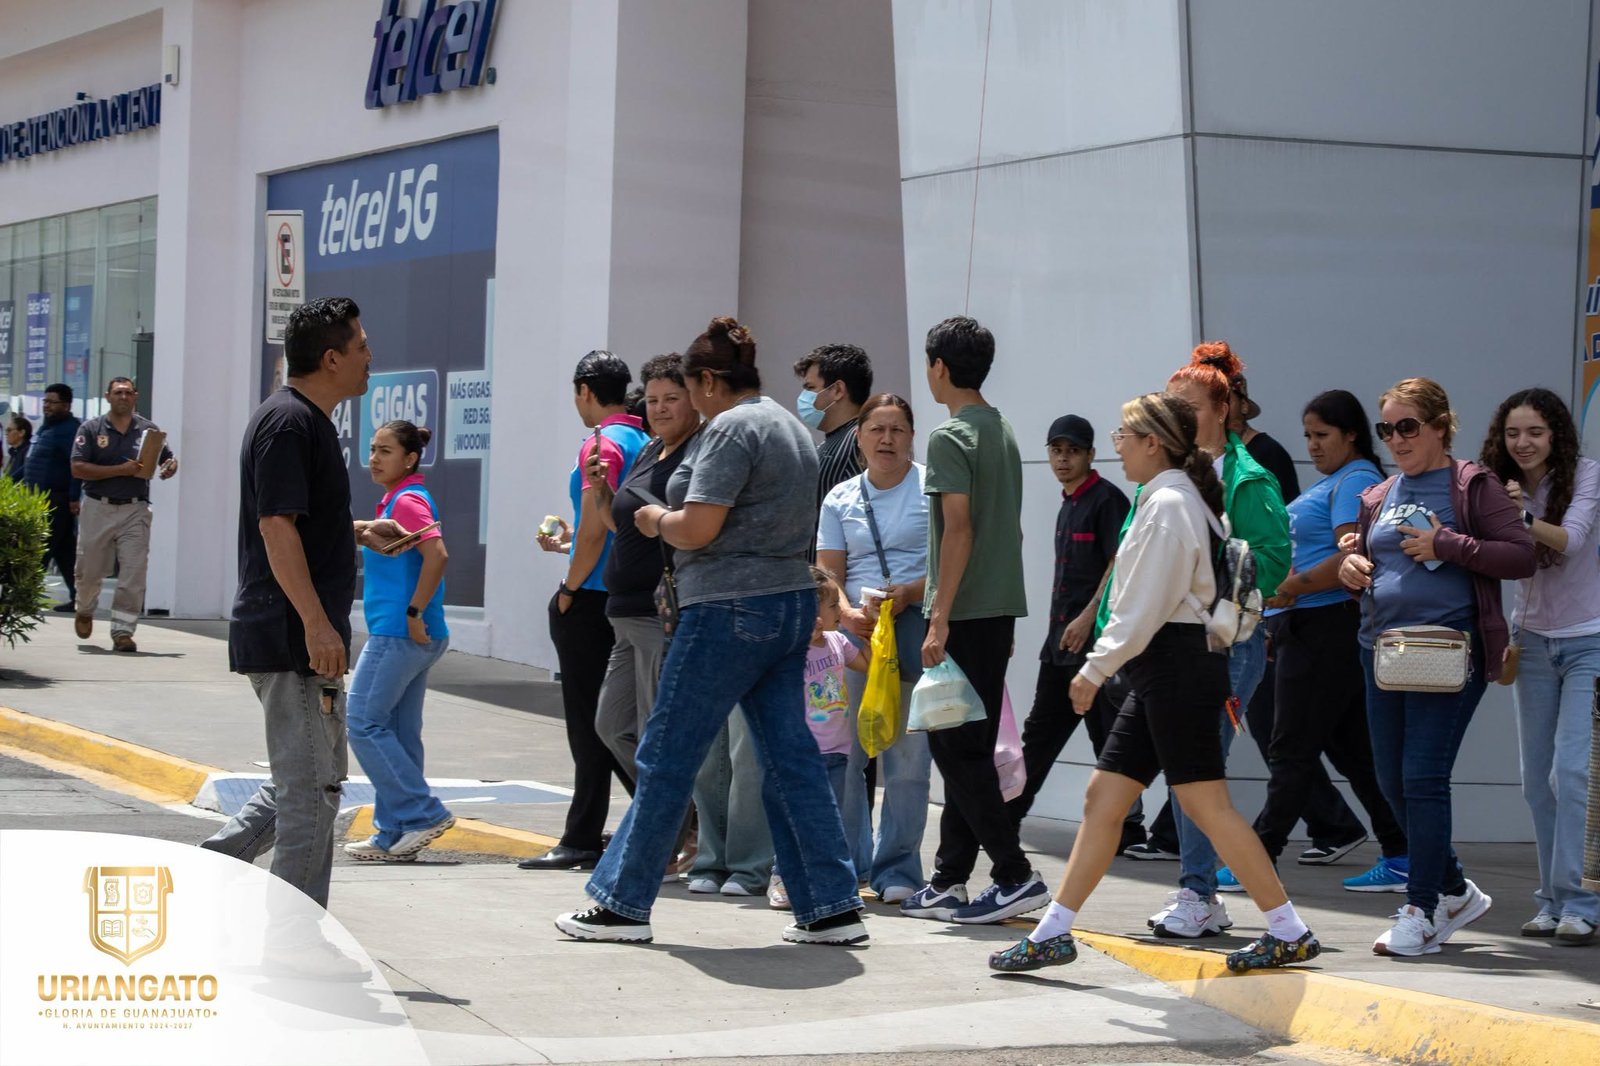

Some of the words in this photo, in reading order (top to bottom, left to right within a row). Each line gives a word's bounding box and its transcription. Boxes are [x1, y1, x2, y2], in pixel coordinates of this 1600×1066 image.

[364, 0, 492, 110] telcel
[1, 122, 26, 161] DE
[92, 98, 107, 139] A
[318, 171, 397, 257] telcel
[394, 163, 438, 244] 5G
[370, 383, 428, 429] GIGAS
[450, 378, 466, 399] MÁS
[463, 407, 478, 425] RED
